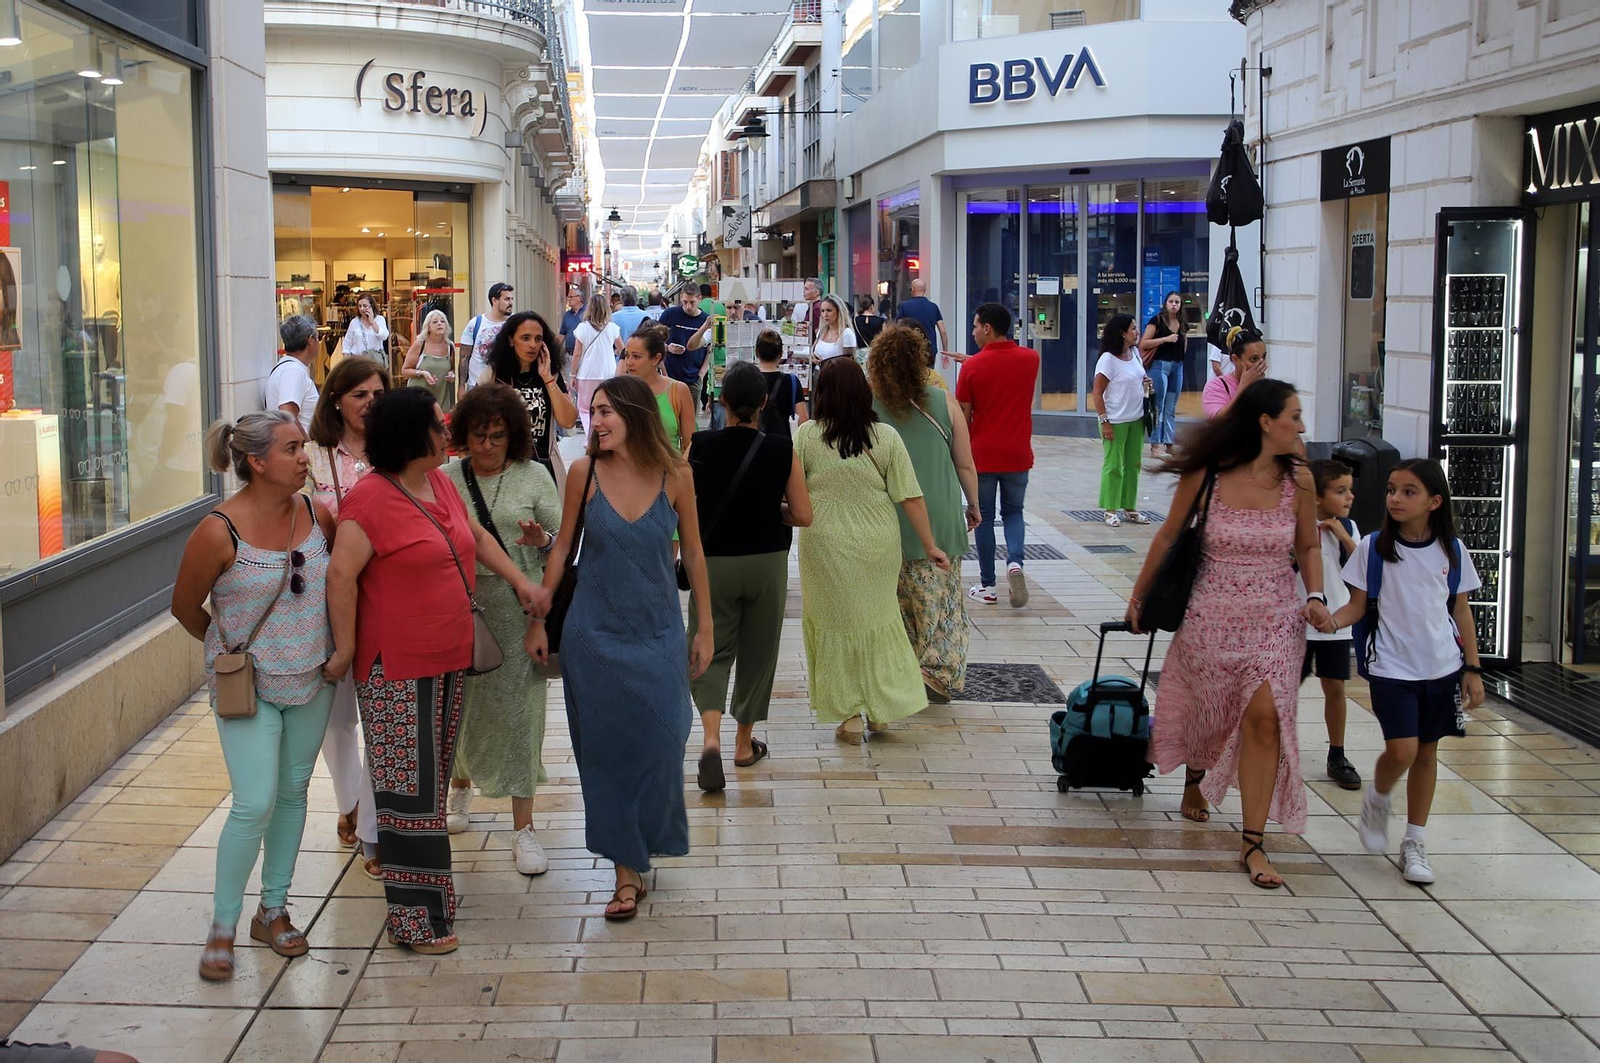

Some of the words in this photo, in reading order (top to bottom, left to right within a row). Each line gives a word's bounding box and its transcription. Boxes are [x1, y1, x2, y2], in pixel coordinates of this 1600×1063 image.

[969, 46, 1106, 104] BBVA
[1352, 233, 1375, 245] OFERTA
[567, 262, 579, 272] 24
